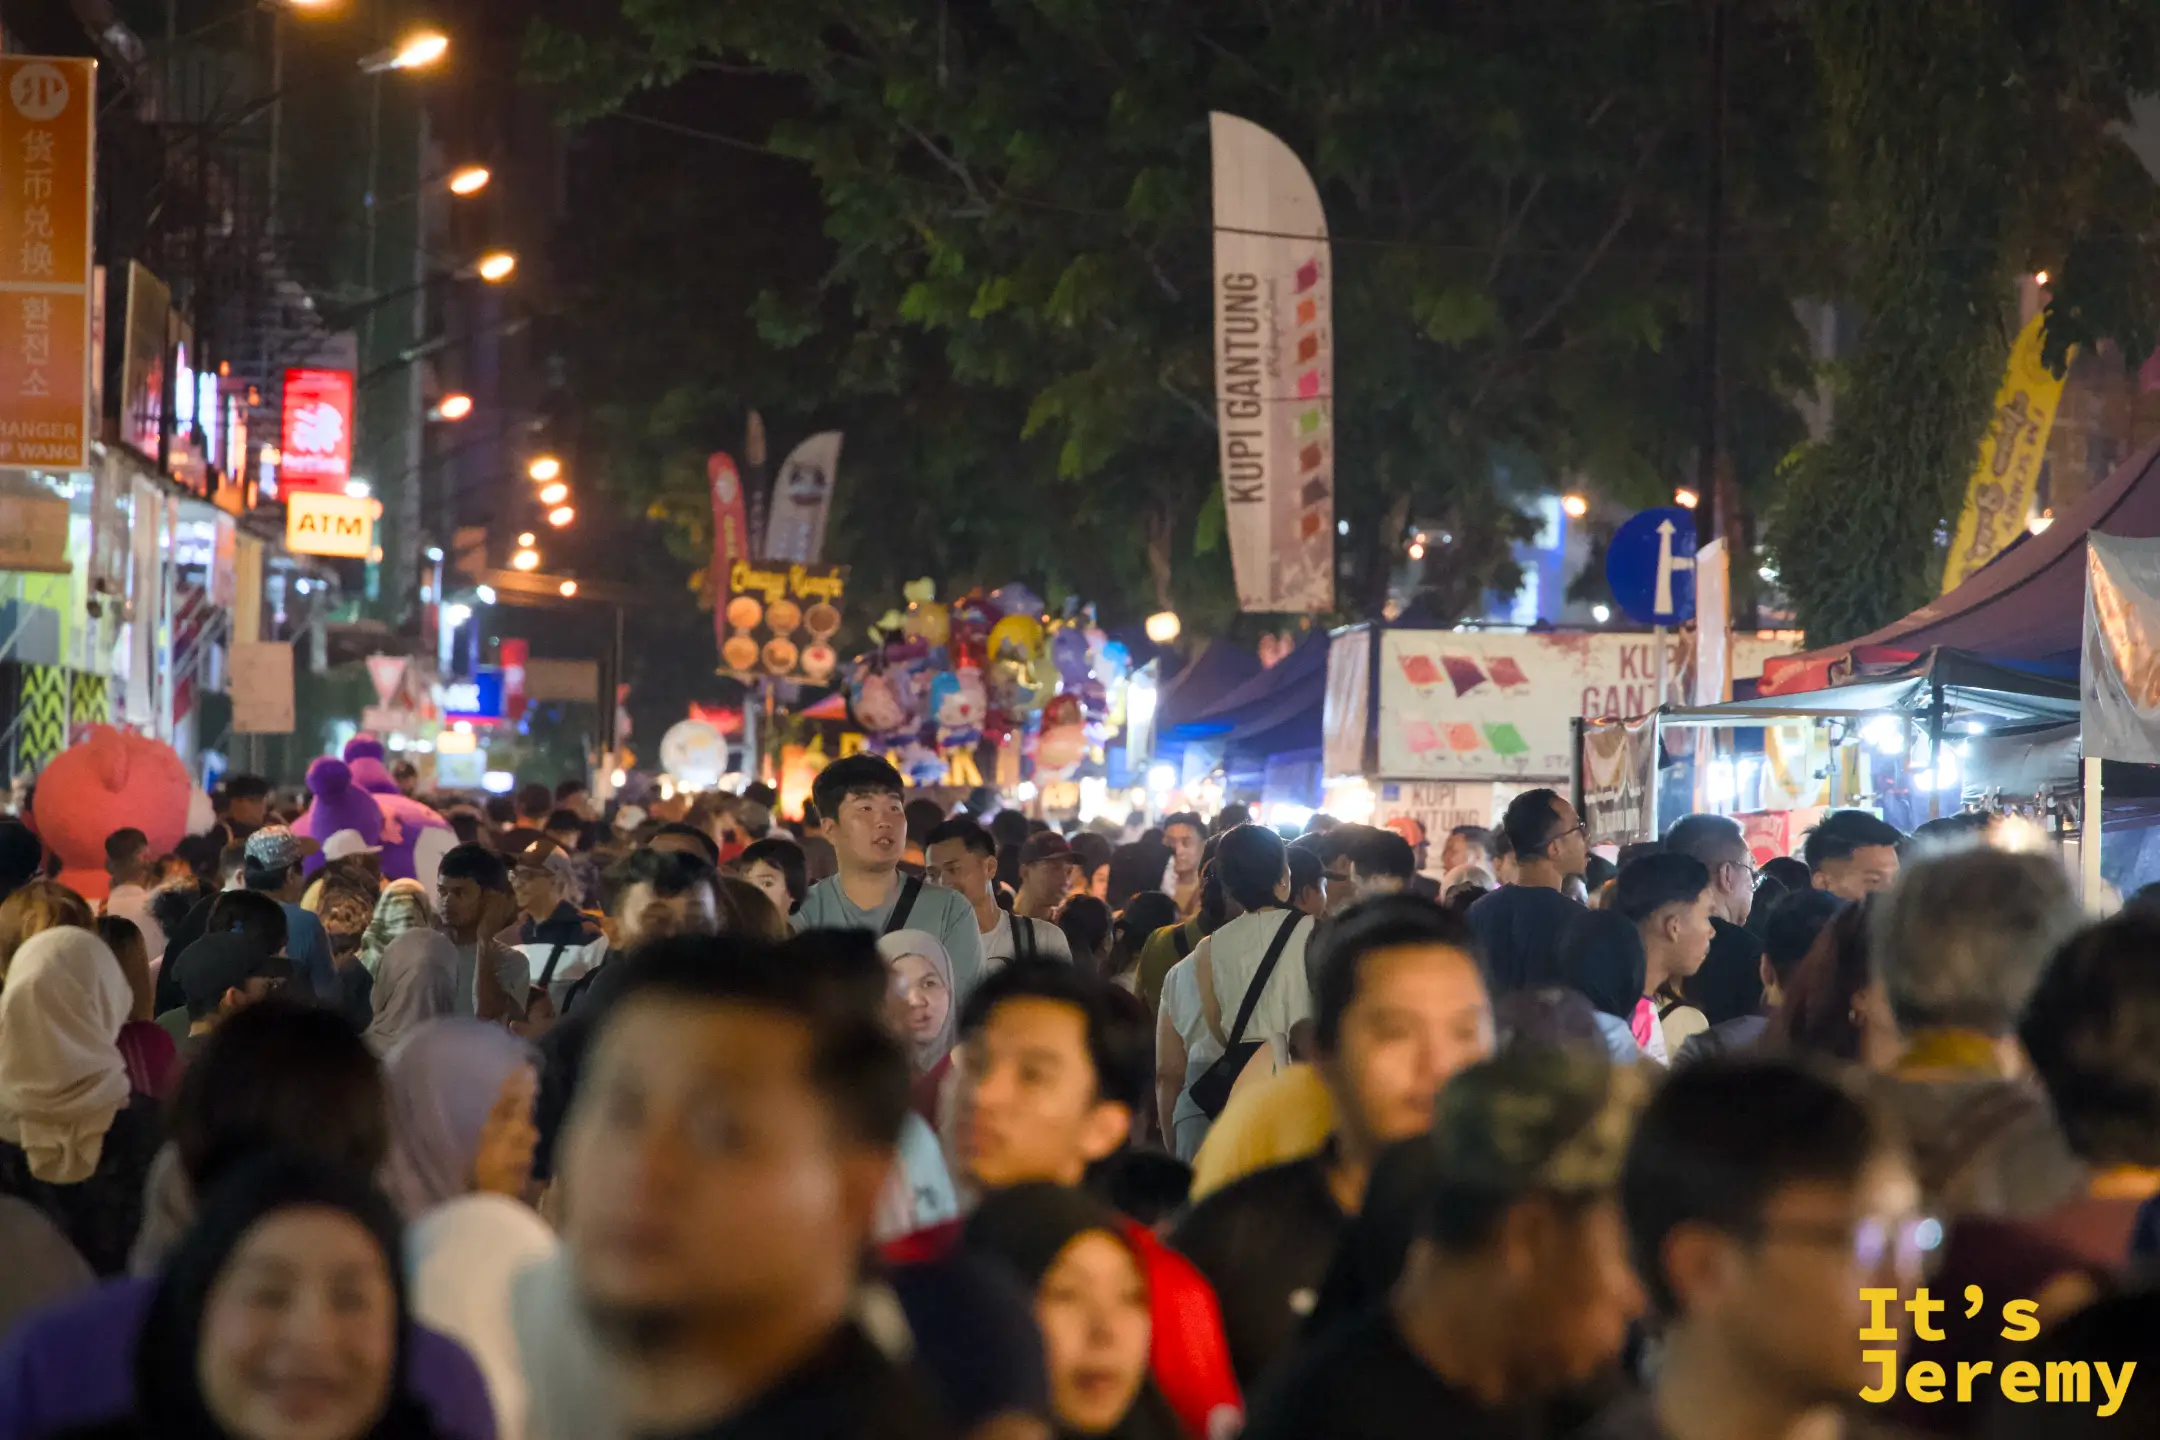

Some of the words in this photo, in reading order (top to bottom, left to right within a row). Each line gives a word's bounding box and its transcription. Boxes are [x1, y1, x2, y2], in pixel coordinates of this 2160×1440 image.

[1222, 271, 1262, 420] GANTUNG
[17, 442, 78, 460] WANG
[1229, 426, 1265, 504] KUPI
[299, 513, 363, 535] ATM
[1412, 783, 1457, 807] KUPI
